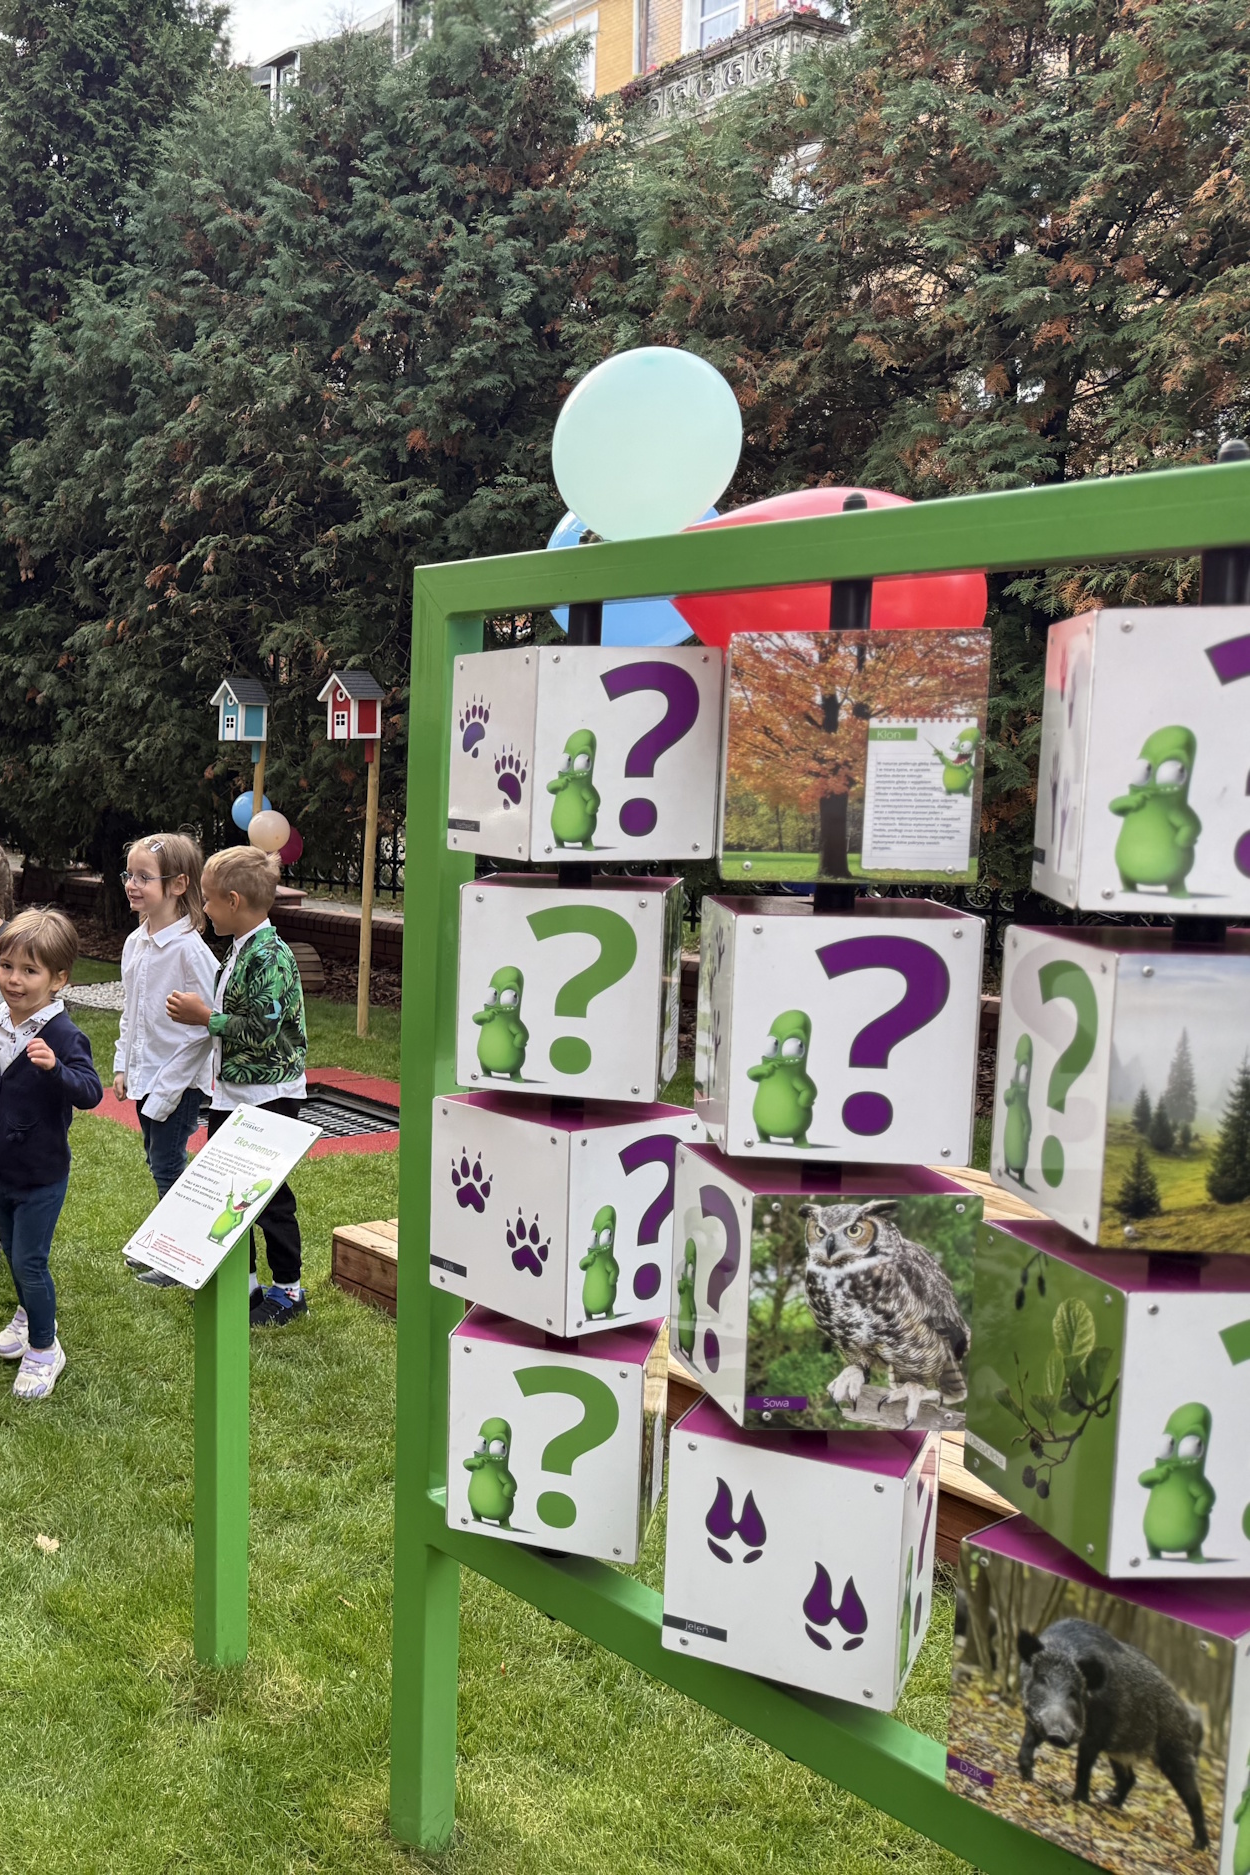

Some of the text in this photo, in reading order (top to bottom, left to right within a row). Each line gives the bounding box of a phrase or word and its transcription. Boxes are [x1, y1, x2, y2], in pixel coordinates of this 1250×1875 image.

[876, 729, 901, 740] Klon
[234, 1136, 281, 1160] Eko-memory
[763, 1398, 789, 1408] Sowa
[684, 1621, 709, 1635] Jeleń
[959, 1761, 982, 1780] Dzik
